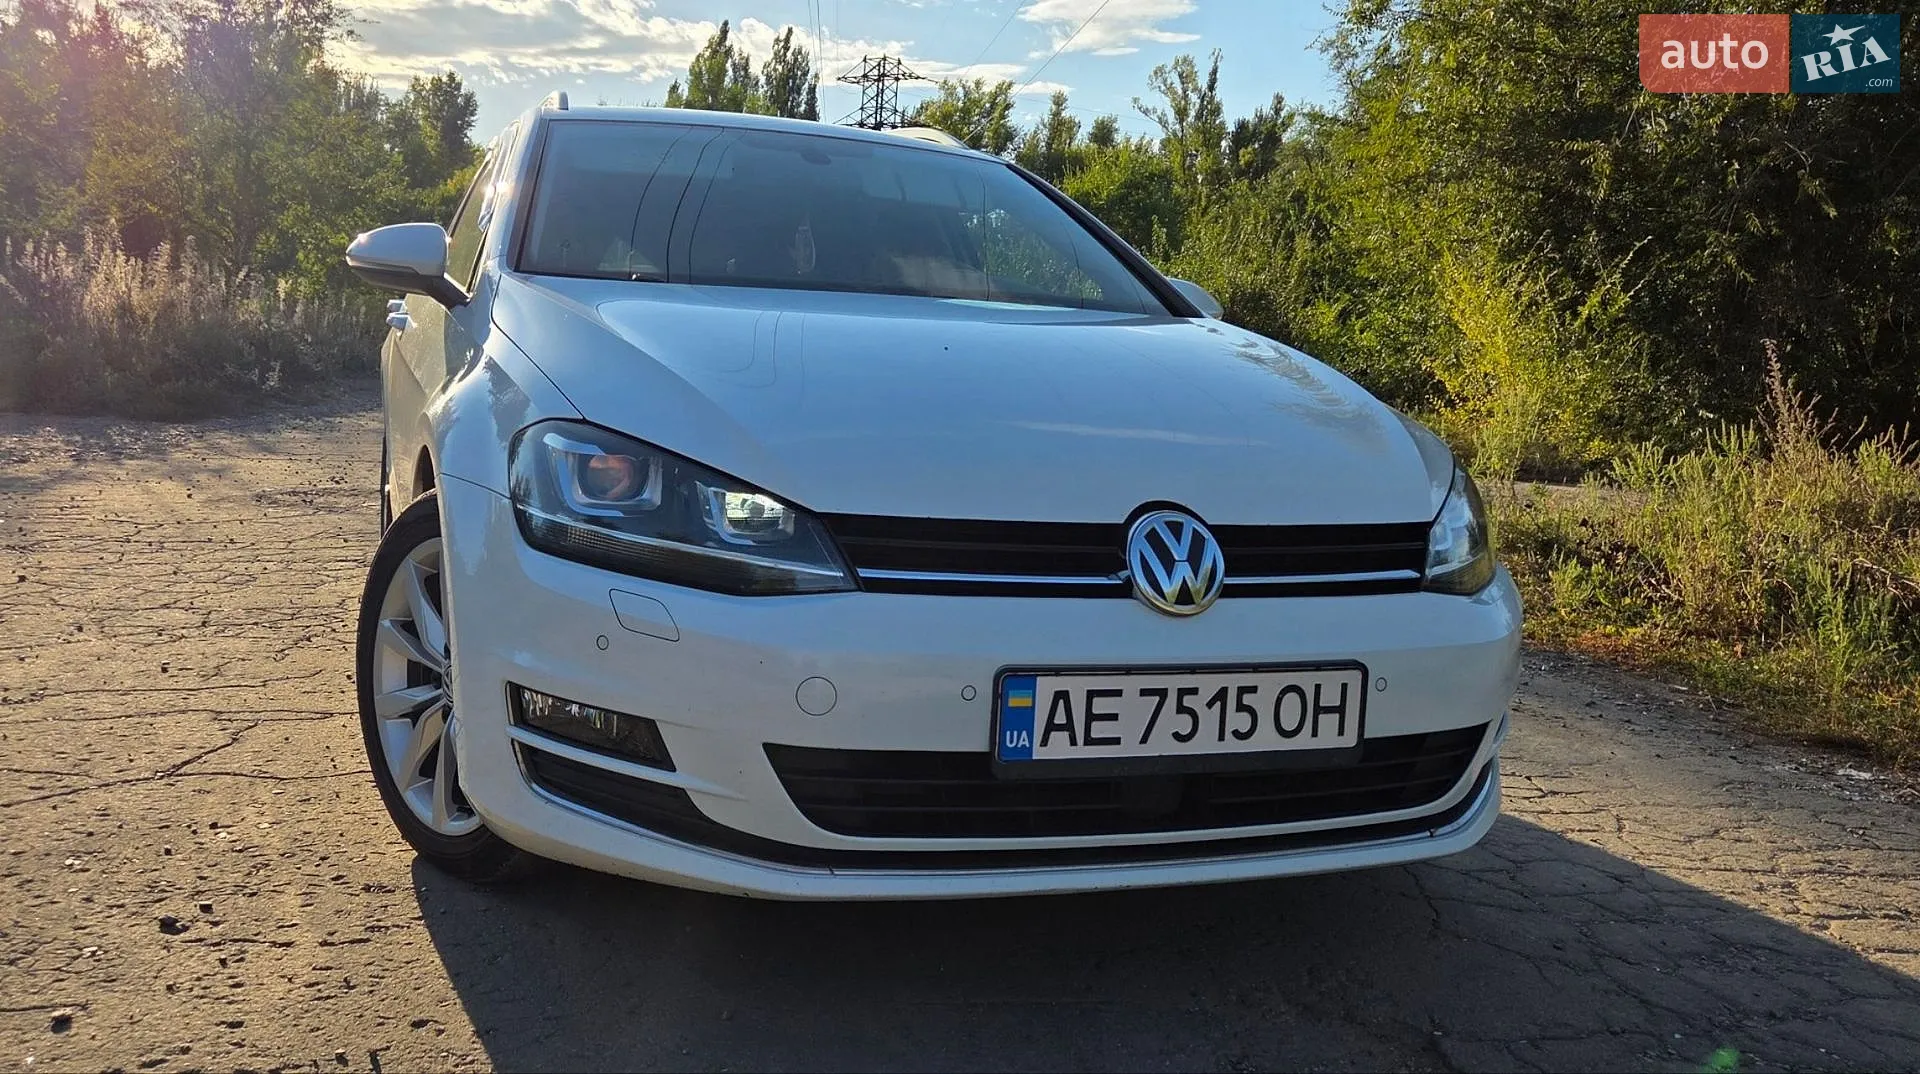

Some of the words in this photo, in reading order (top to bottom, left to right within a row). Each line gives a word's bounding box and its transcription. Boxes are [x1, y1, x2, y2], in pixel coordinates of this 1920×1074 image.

[1130, 514, 1221, 609] VW
[1006, 730, 1030, 748] UA
[1039, 688, 1123, 748] AE
[1138, 685, 1258, 744] 7515
[1273, 682, 1349, 739] OH
